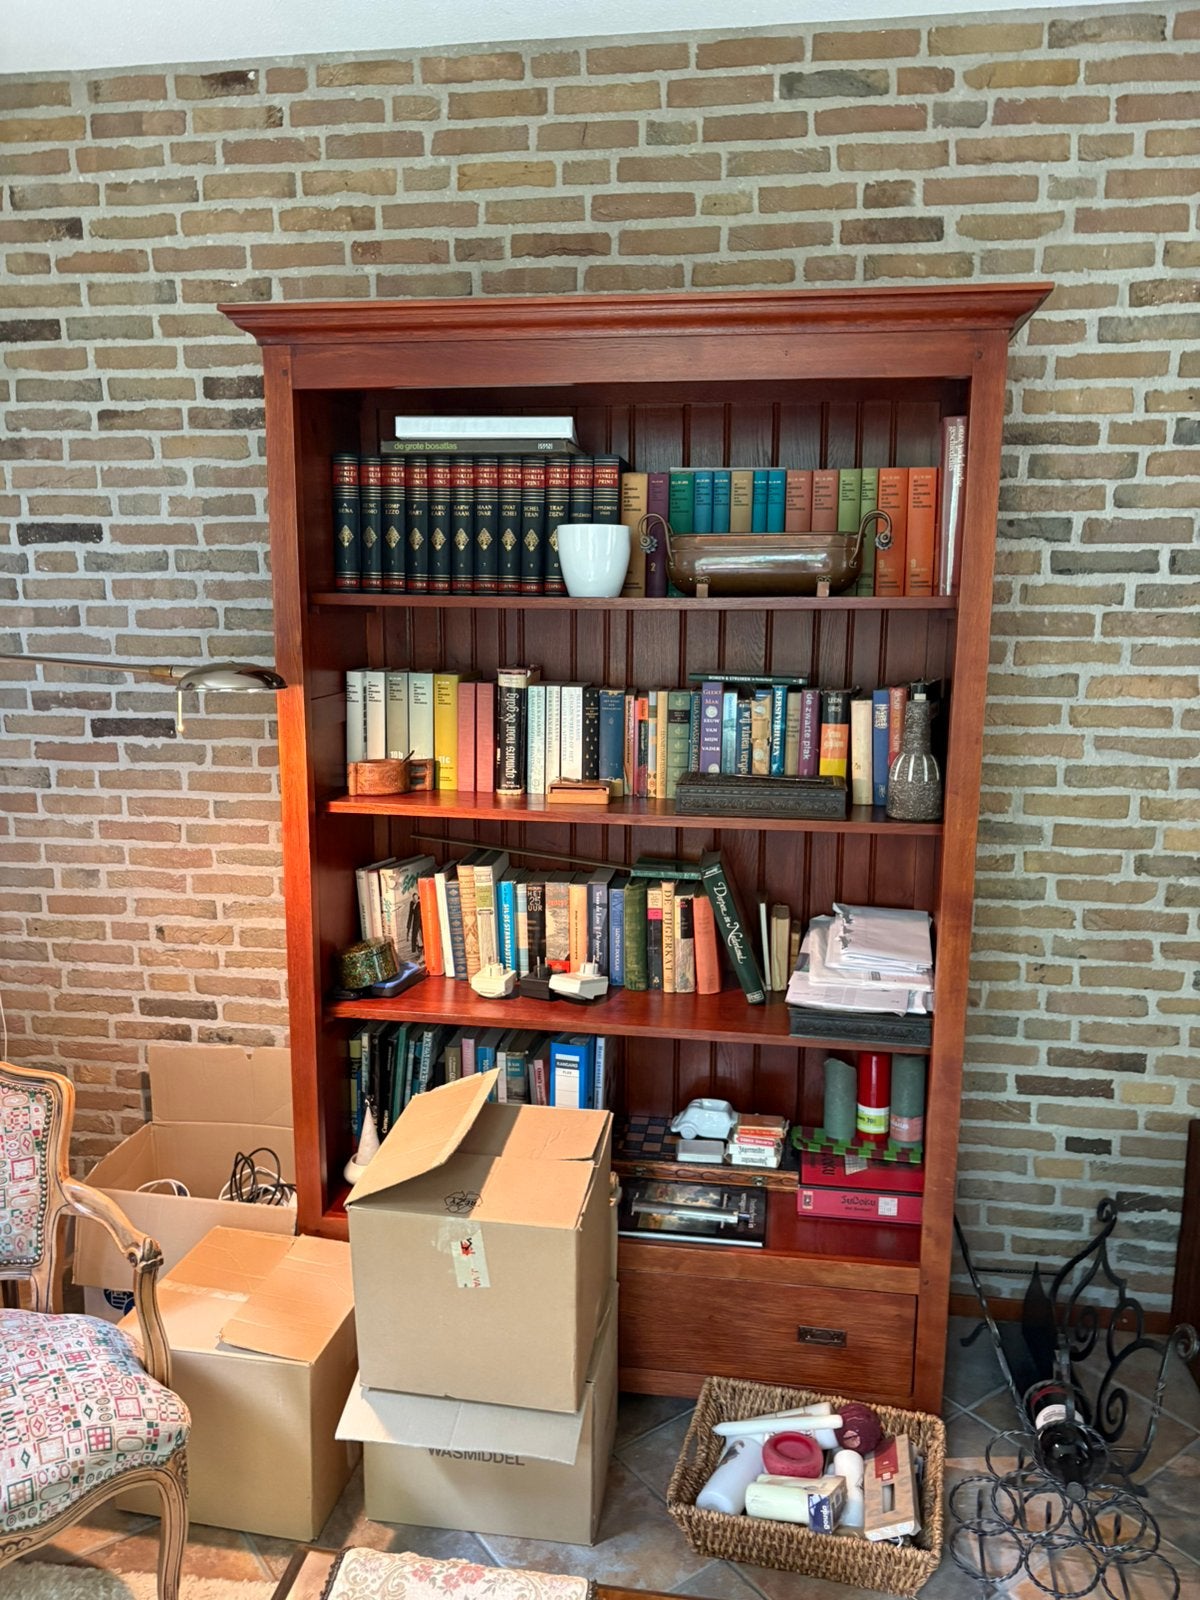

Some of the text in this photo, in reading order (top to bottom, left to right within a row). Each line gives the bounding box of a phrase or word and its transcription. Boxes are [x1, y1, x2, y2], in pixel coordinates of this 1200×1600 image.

[394, 442, 457, 451] de grote bosatlas
[650, 562, 656, 571] 2
[502, 692, 519, 779] opmars naar de galg
[773, 690, 783, 756] KERSTVERHALEN
[803, 693, 815, 760] de zwarte plak
[737, 750, 749, 774] verge
[503, 923, 512, 970] STRANDJUTTE
[664, 889, 673, 972] DE TIJGERKAT
[428, 1447, 525, 1466] WASMIDDEL
[820, 1505, 831, 1530] gouda
